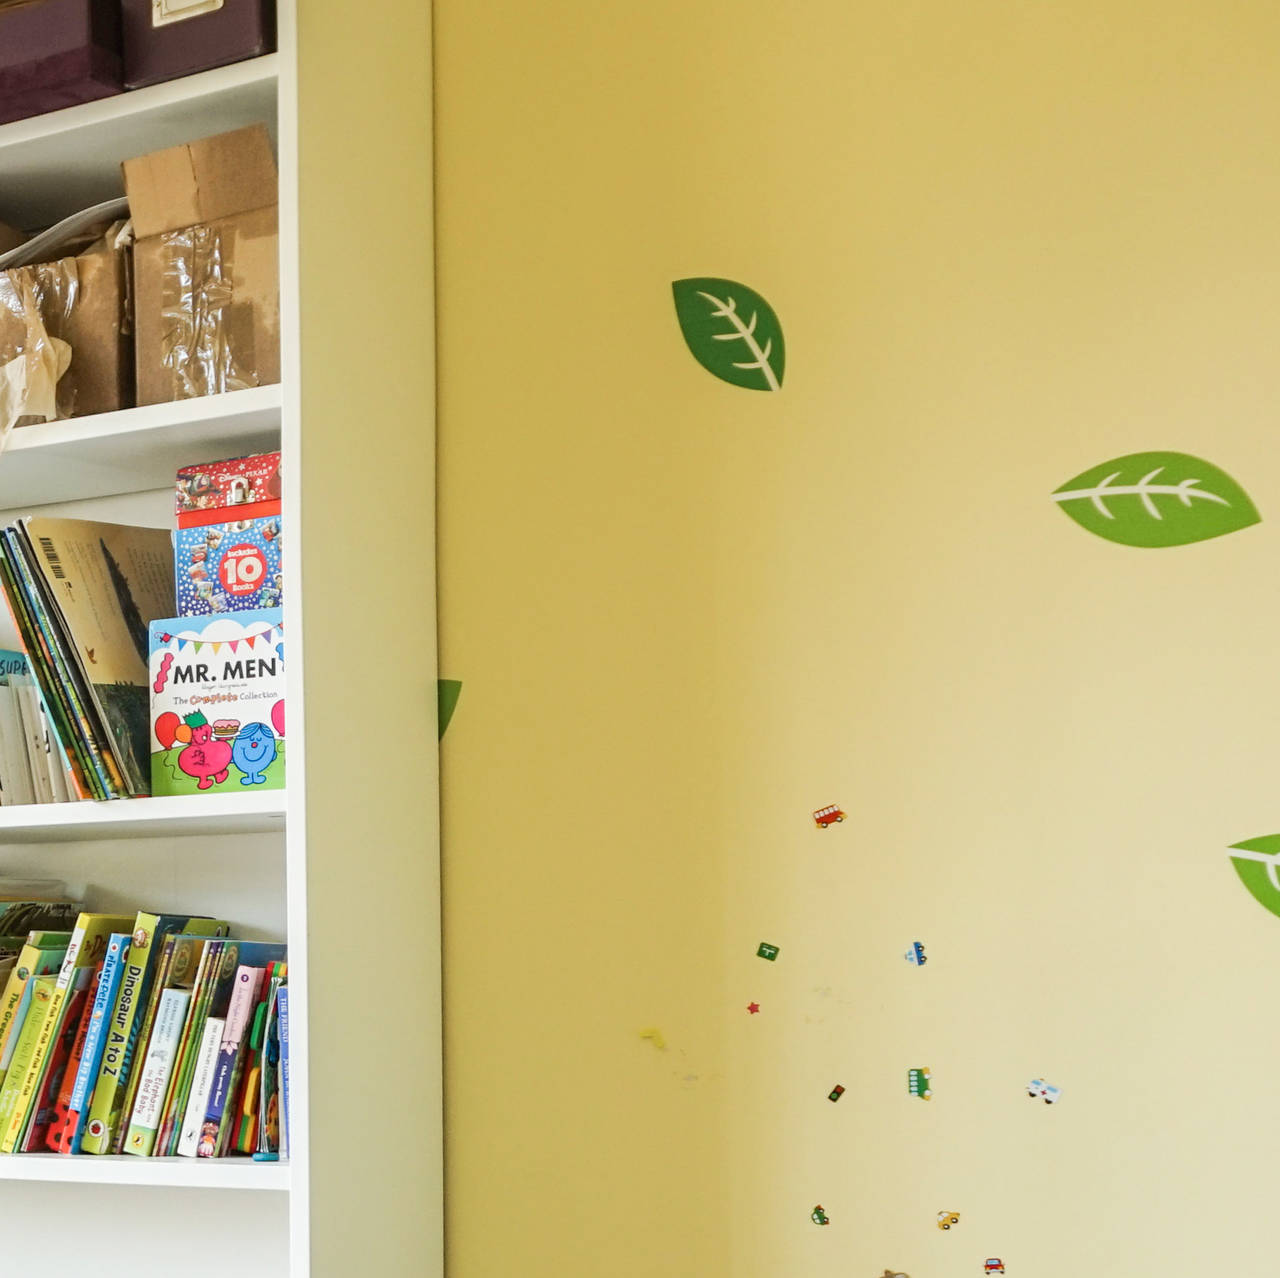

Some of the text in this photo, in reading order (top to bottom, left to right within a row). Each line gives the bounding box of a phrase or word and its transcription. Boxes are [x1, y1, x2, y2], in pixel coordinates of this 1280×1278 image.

[223, 556, 263, 585] 10
[0, 659, 30, 678] SUPE
[173, 657, 276, 684] MR. MEN
[189, 692, 238, 705] Complete
[240, 691, 278, 700] Collection
[6, 991, 19, 1010] The
[95, 982, 109, 1009] Pete
[101, 964, 141, 1077] Dinosaur A to Z
[279, 998, 288, 1042] THE FRIEND
[141, 1077, 155, 1094] Bad
[144, 1075, 165, 1113] Elephant
[133, 1092, 150, 1115] Baby
